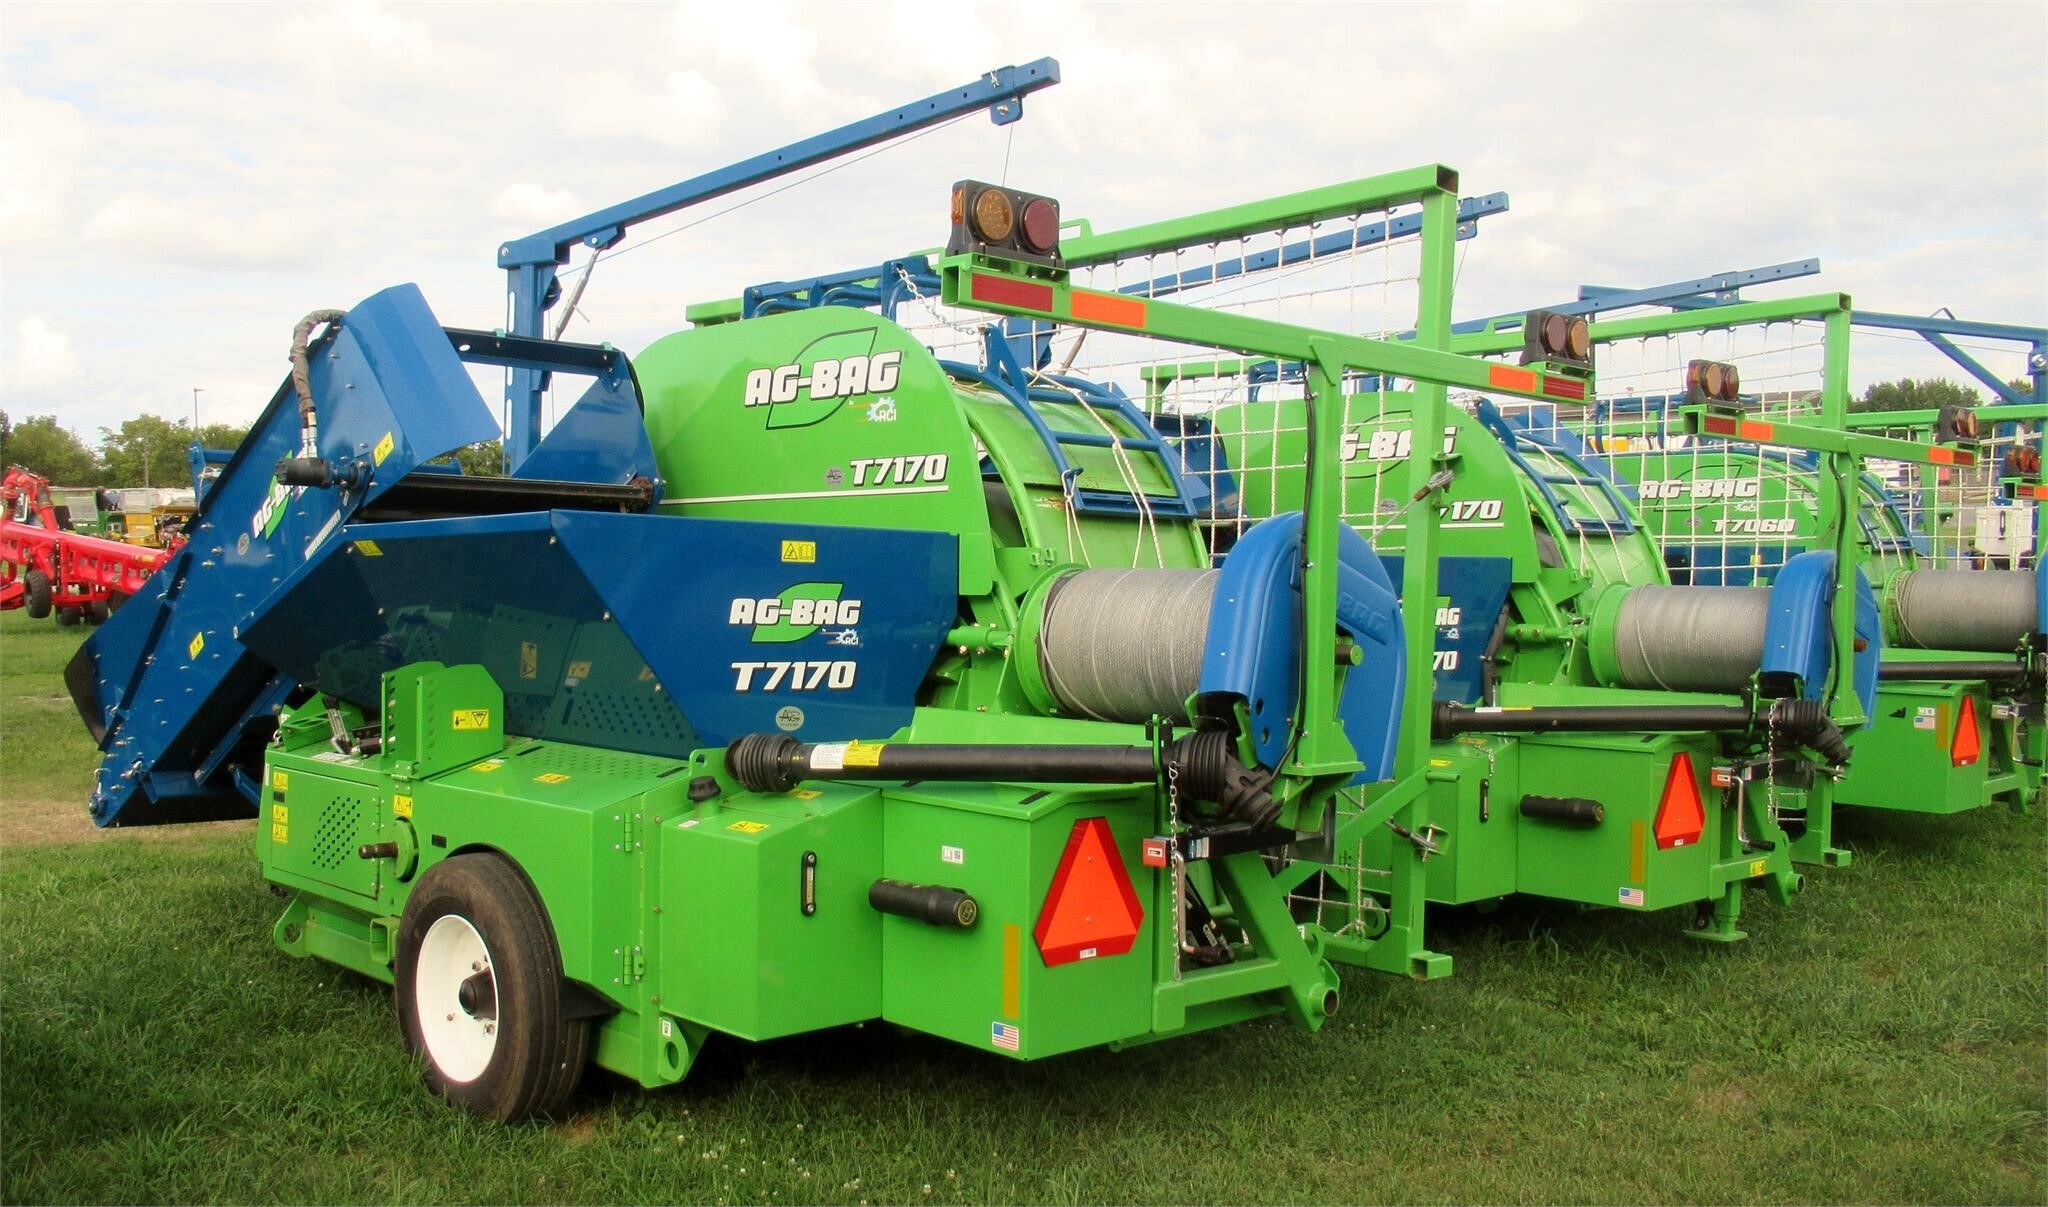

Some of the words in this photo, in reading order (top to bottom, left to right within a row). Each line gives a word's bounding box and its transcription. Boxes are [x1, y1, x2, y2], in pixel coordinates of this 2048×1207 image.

[744, 351, 903, 408] AG-BAG
[878, 408, 897, 422] RCI
[849, 454, 949, 486] T7170
[1639, 478, 1759, 499] AG-BAG
[1712, 518, 1796, 533] T7060
[728, 598, 863, 626] AG-BAG
[731, 661, 857, 692] T7170
